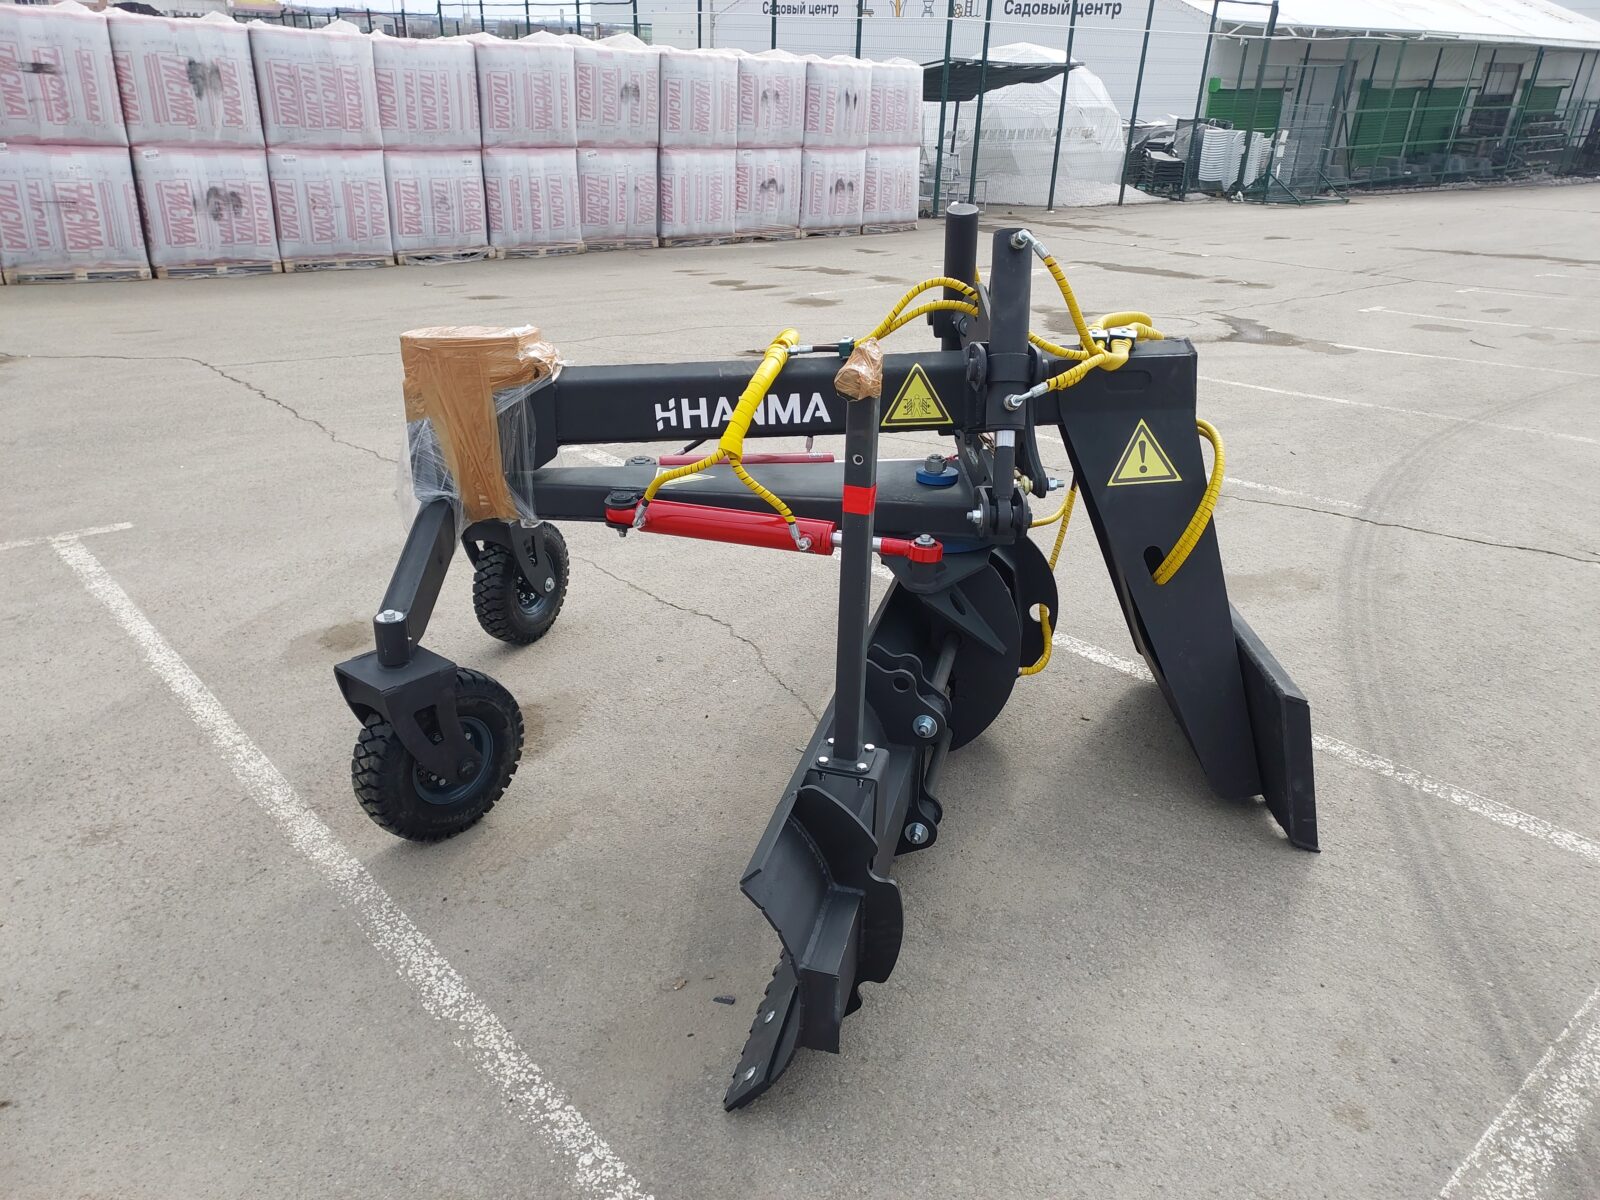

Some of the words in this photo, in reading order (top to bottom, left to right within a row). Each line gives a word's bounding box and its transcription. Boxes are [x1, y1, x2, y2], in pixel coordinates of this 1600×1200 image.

[809, 4, 839, 17] центр
[1004, 0, 1071, 18] Садовый
[273, 62, 299, 125] ТИСМА
[343, 68, 363, 130] ТИСМА
[420, 72, 437, 130] ТИСМА
[493, 74, 510, 129] ТИСМА
[669, 81, 681, 130] ТИСМА
[276, 183, 300, 240] ТИСМА
[401, 181, 422, 234] ТИСМА
[434, 181, 451, 234] ТИСМА
[463, 179, 482, 232] ТИСМА
[550, 176, 565, 228] ТИСМА
